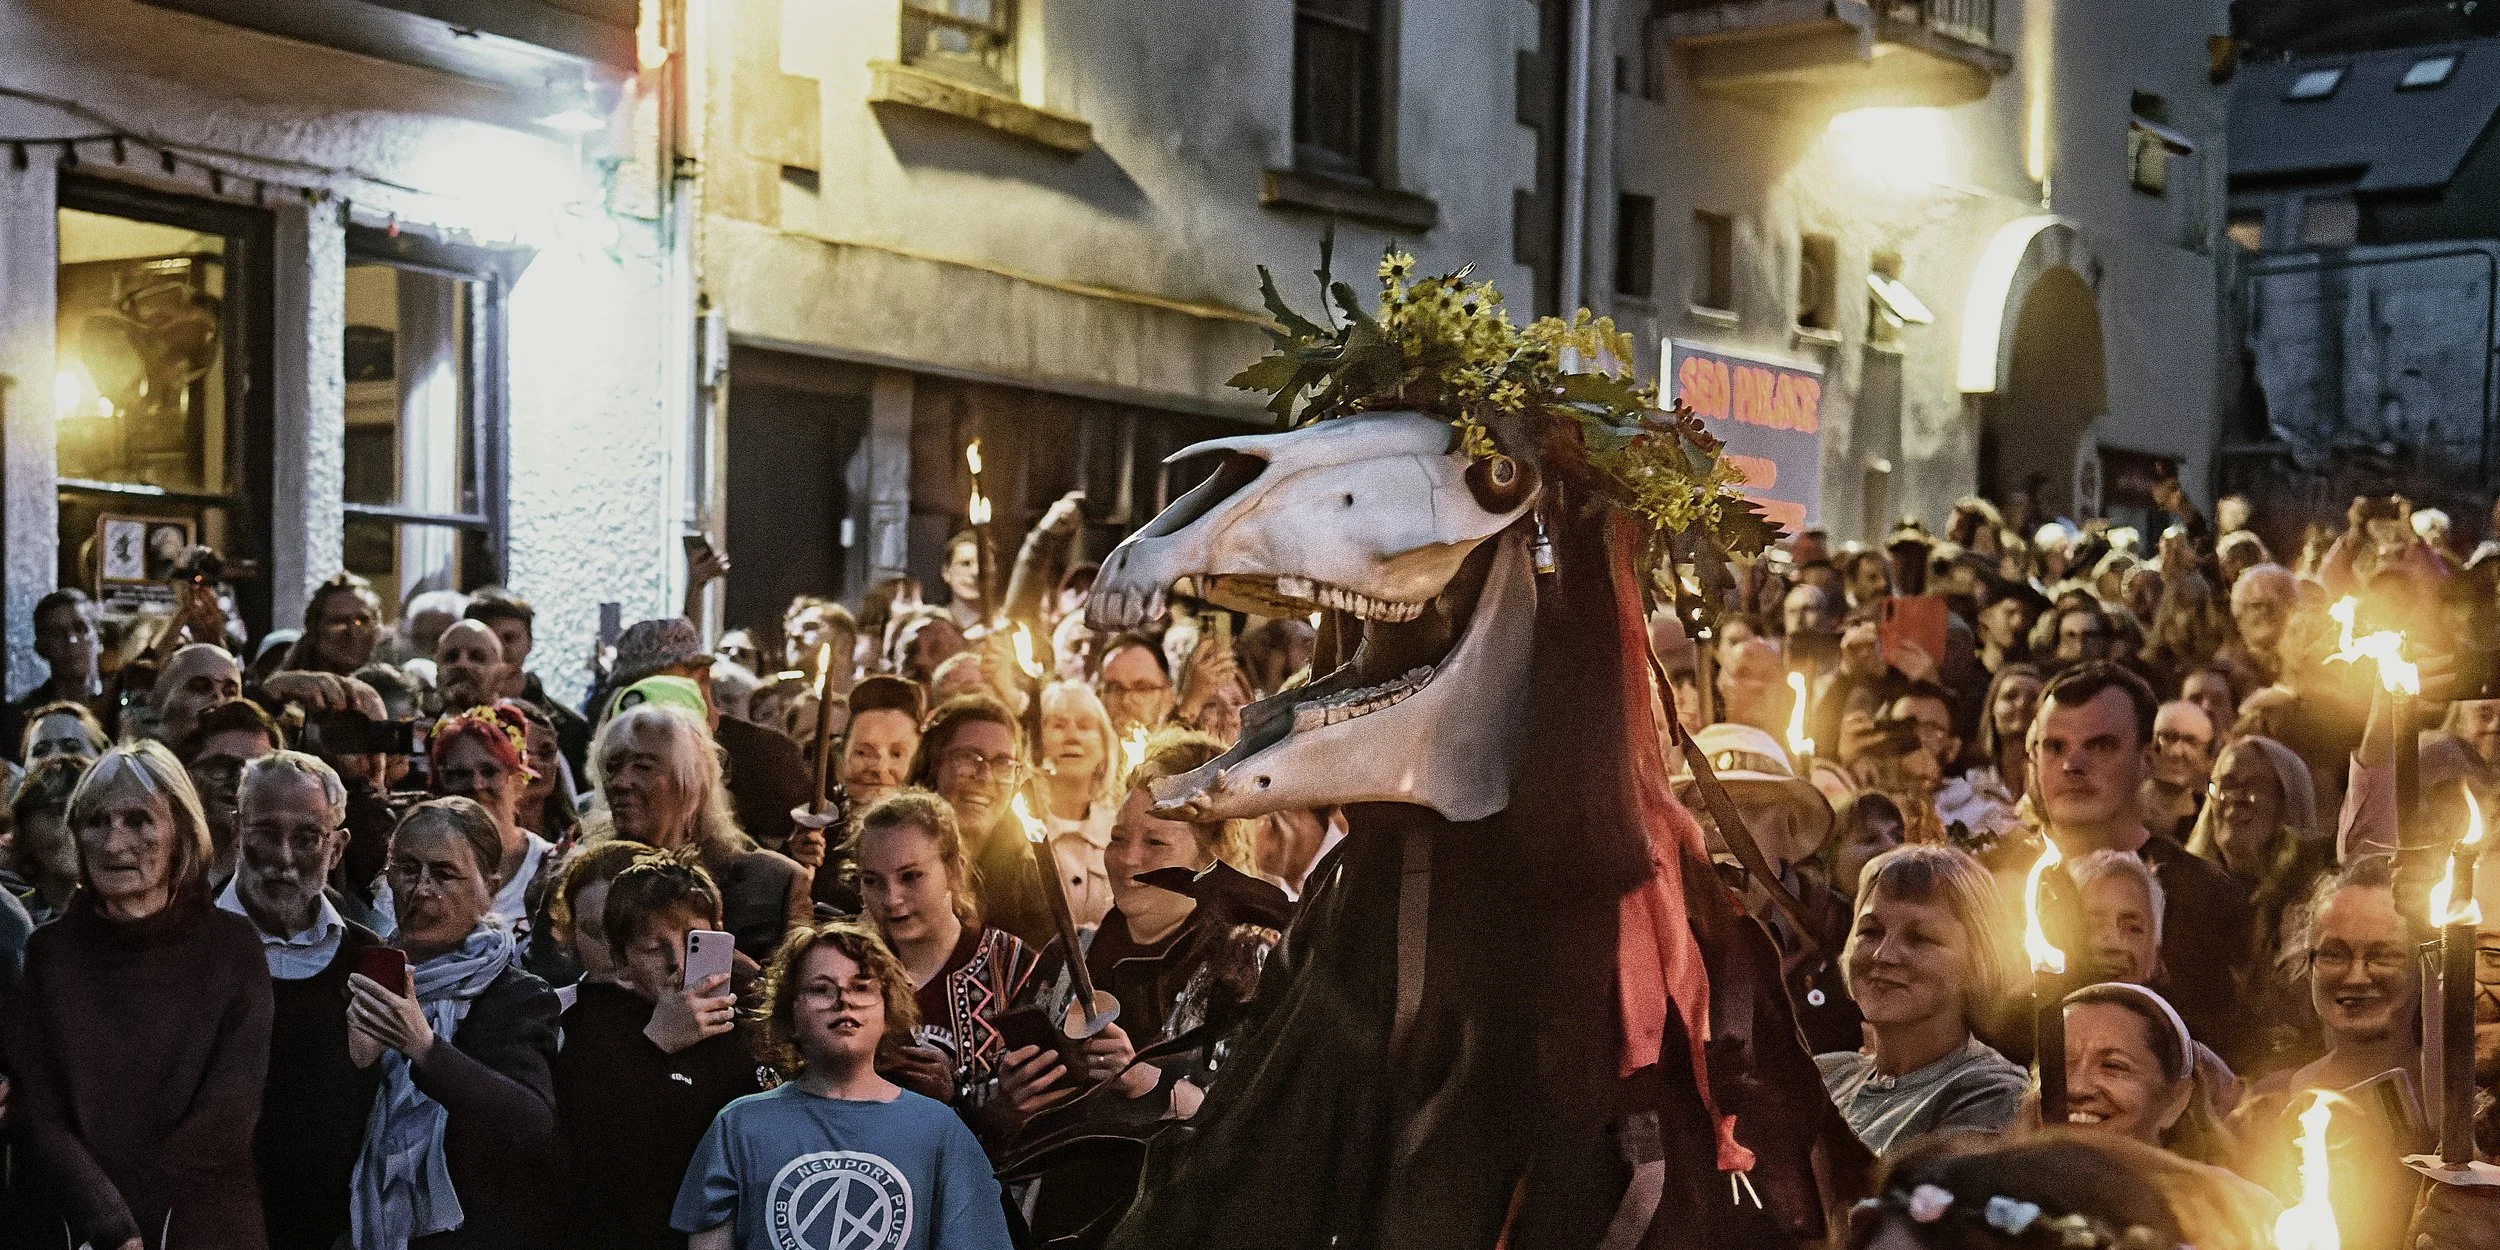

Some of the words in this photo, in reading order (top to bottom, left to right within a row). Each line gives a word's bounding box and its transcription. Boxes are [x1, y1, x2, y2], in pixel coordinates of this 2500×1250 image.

[775, 1201, 801, 1250] BOAR
[796, 1158, 895, 1187] NEWPORT
[887, 1192, 906, 1245] PLUS
